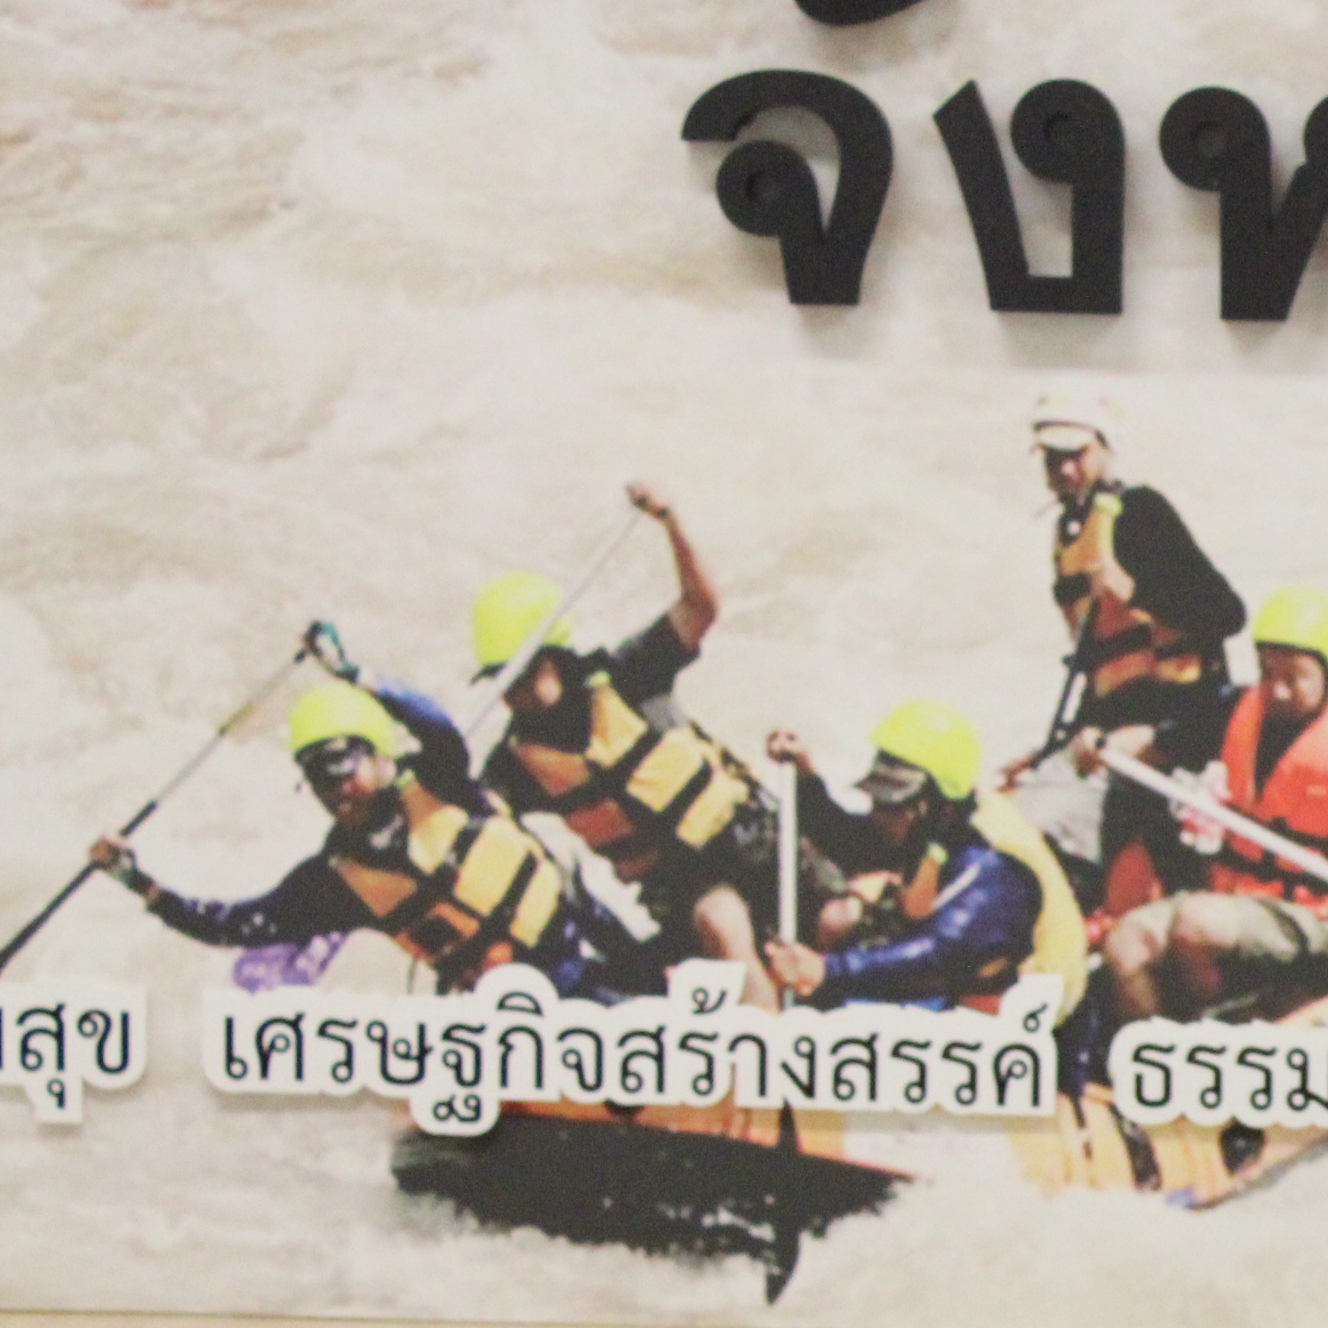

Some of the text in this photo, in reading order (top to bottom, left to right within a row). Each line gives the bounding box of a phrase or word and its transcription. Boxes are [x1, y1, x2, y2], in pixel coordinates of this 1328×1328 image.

[0, 1002, 130, 1110] สุข
[223, 987, 1051, 1124] เศรษฐกิจสร้างสรรค์
